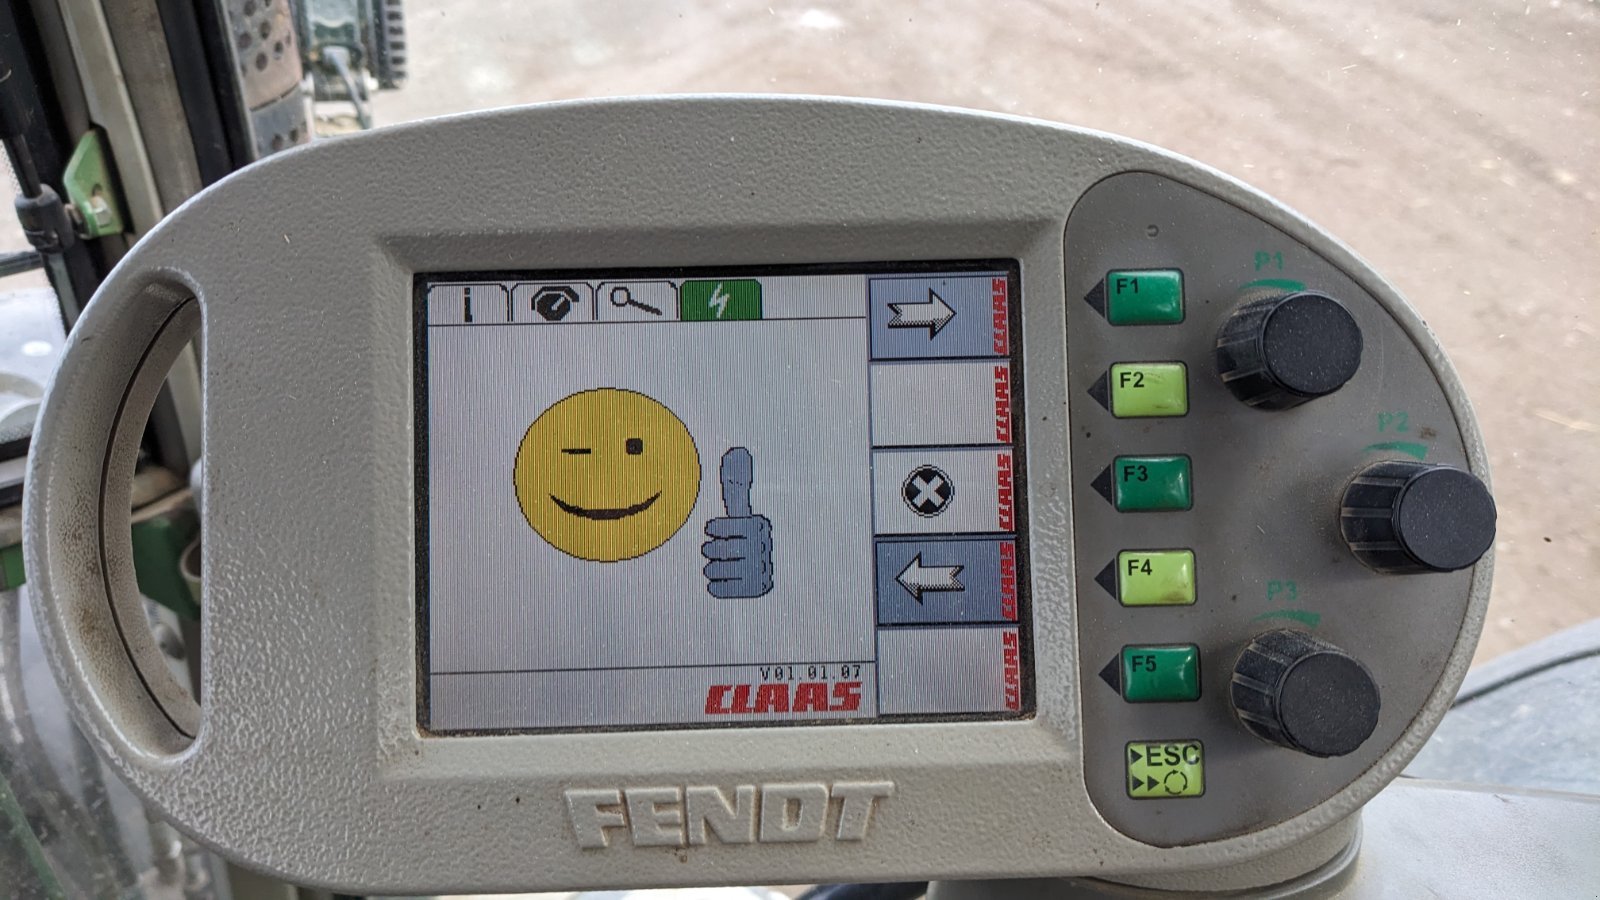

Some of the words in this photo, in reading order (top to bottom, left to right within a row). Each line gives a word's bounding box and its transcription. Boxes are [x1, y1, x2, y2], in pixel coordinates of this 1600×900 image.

[1254, 250, 1285, 272] P1
[1116, 276, 1139, 295] F1
[993, 277, 1009, 357] CLAAS
[1120, 371, 1145, 389] F2
[995, 365, 1011, 444] CLAAS
[1377, 411, 1410, 433] P2
[1124, 465, 1149, 483] F3
[997, 453, 1013, 532] CLAAS
[1127, 558, 1153, 577] F4
[1001, 542, 1017, 621] CLAAS
[1266, 580, 1298, 602] P3
[760, 664, 861, 681] V01.01.07
[1003, 631, 1019, 710] CLAAS
[1132, 655, 1158, 673] F5
[705, 682, 862, 715] CLAAS
[1146, 743, 1201, 767] ESC
[564, 780, 897, 850] FENDT
